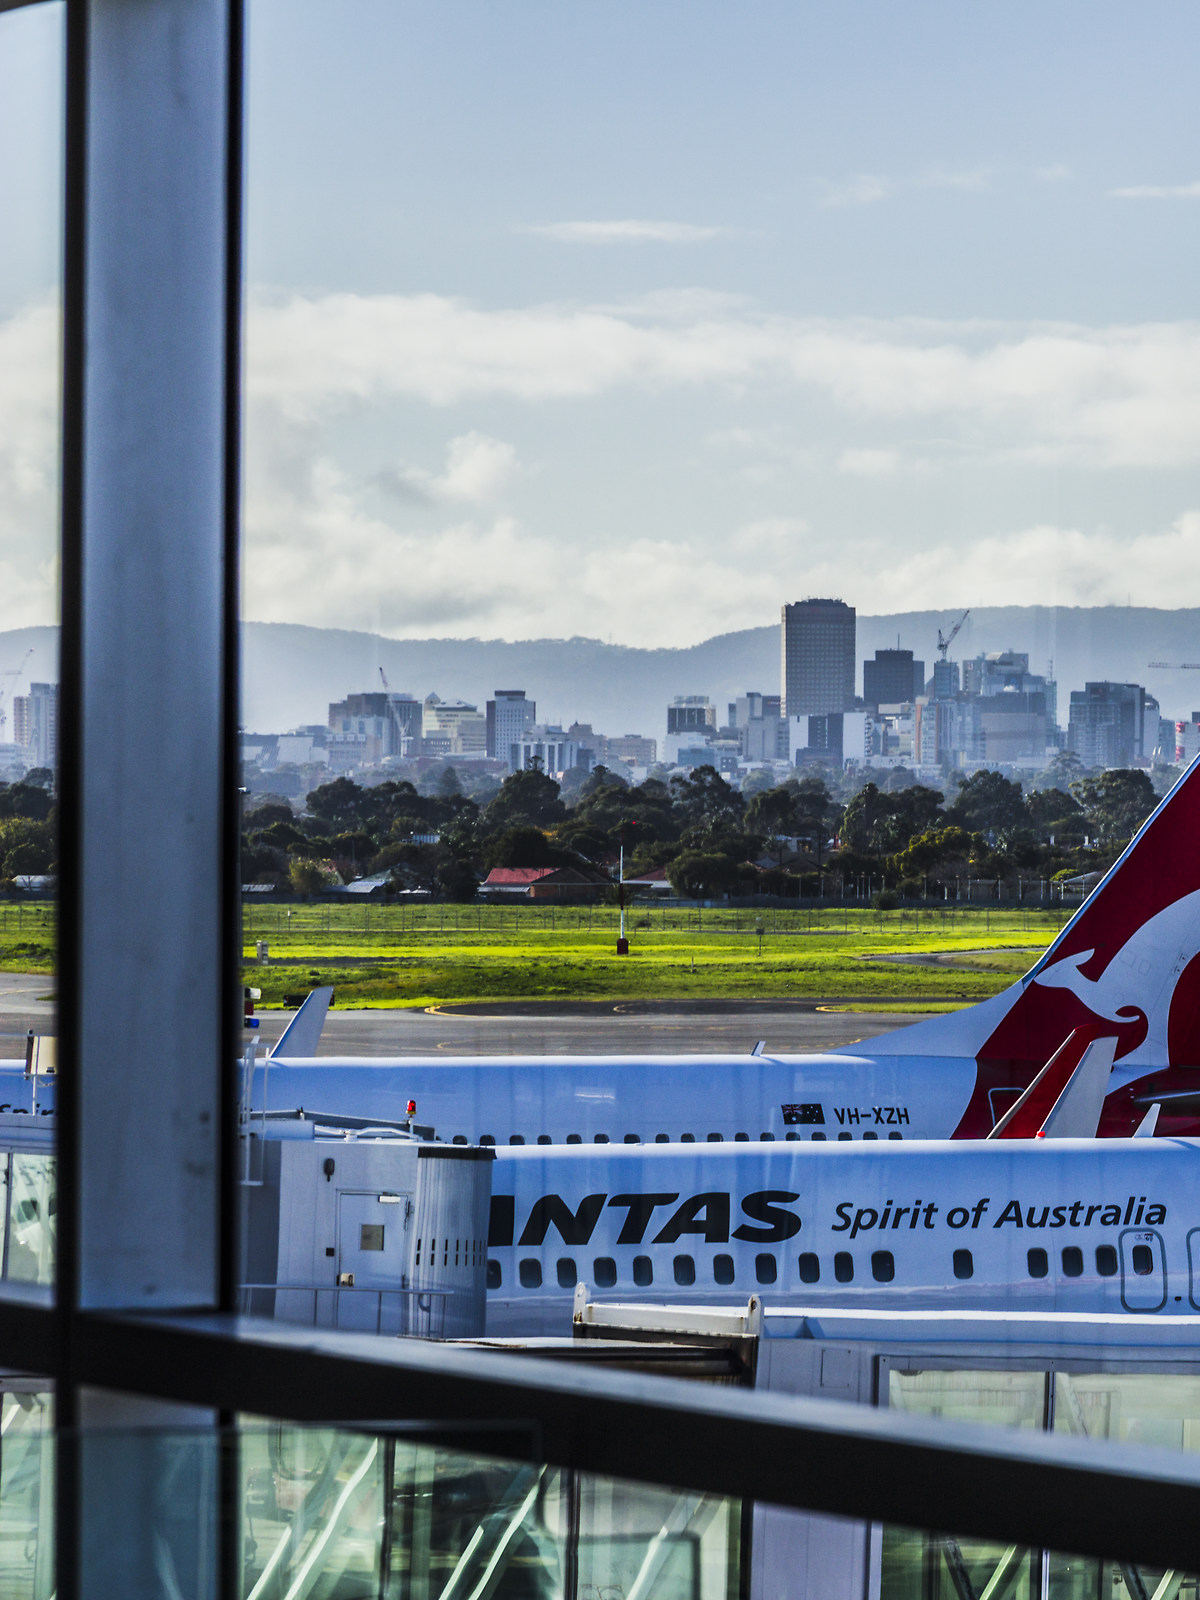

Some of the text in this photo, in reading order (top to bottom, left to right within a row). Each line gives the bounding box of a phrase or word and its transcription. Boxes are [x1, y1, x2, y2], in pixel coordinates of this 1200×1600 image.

[834, 1107, 910, 1125] VH-XZH
[831, 1196, 1167, 1239] Spirit of Australia
